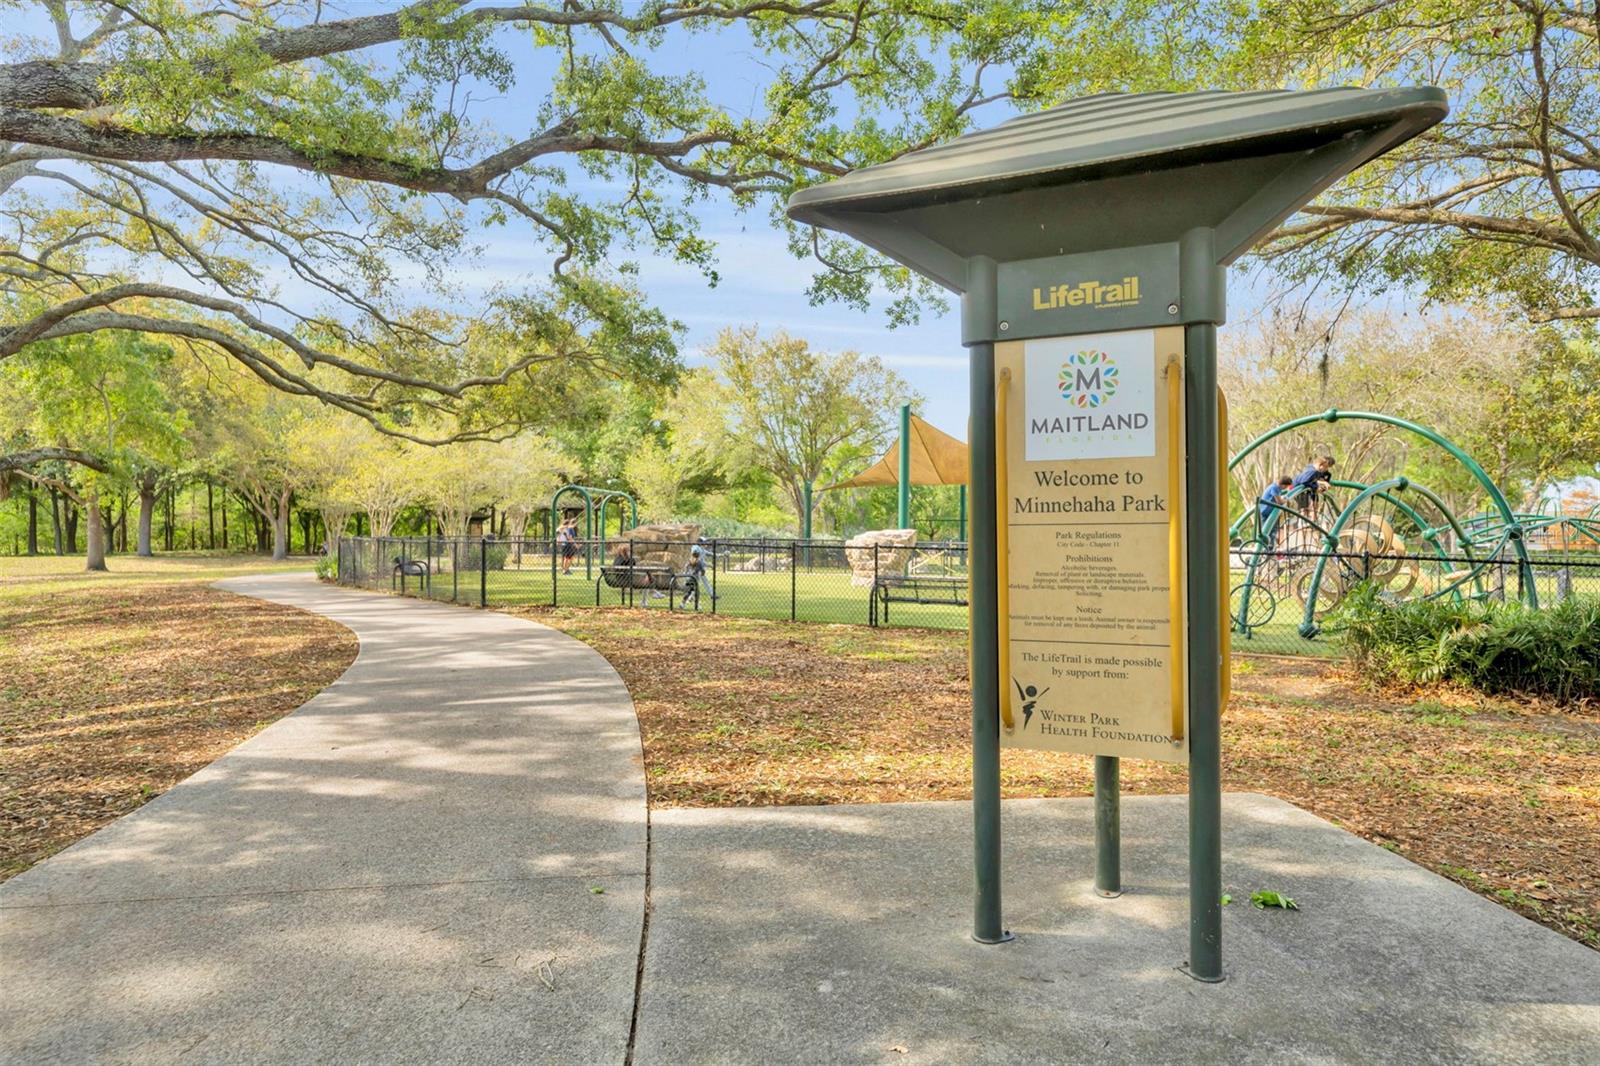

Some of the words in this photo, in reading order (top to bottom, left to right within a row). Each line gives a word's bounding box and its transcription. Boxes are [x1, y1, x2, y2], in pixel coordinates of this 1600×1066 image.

[1033, 276, 1139, 310] LifeTrail
[1076, 367, 1101, 391] M
[1032, 413, 1148, 434] MAITLAND
[1035, 470, 1119, 487] Welcome
[1126, 471, 1143, 485] to
[1015, 496, 1115, 514] Minnehaha
[1123, 494, 1165, 512] Park
[1056, 531, 1072, 539] Park
[1075, 531, 1121, 541] Regulations
[1066, 555, 1113, 563] Prohibitions
[1076, 605, 1102, 614] Notice
[1022, 652, 1039, 662] The
[1042, 652, 1081, 664] LifeTrail
[1085, 654, 1092, 664] is
[1095, 655, 1120, 666] made
[1123, 657, 1163, 668] possible
[1052, 667, 1062, 678] by
[1066, 668, 1101, 679] support
[1103, 669, 1129, 679] from:
[1040, 710, 1087, 724] WINTER
[1090, 712, 1120, 726] PARK
[1041, 723, 1087, 737] HEALTH
